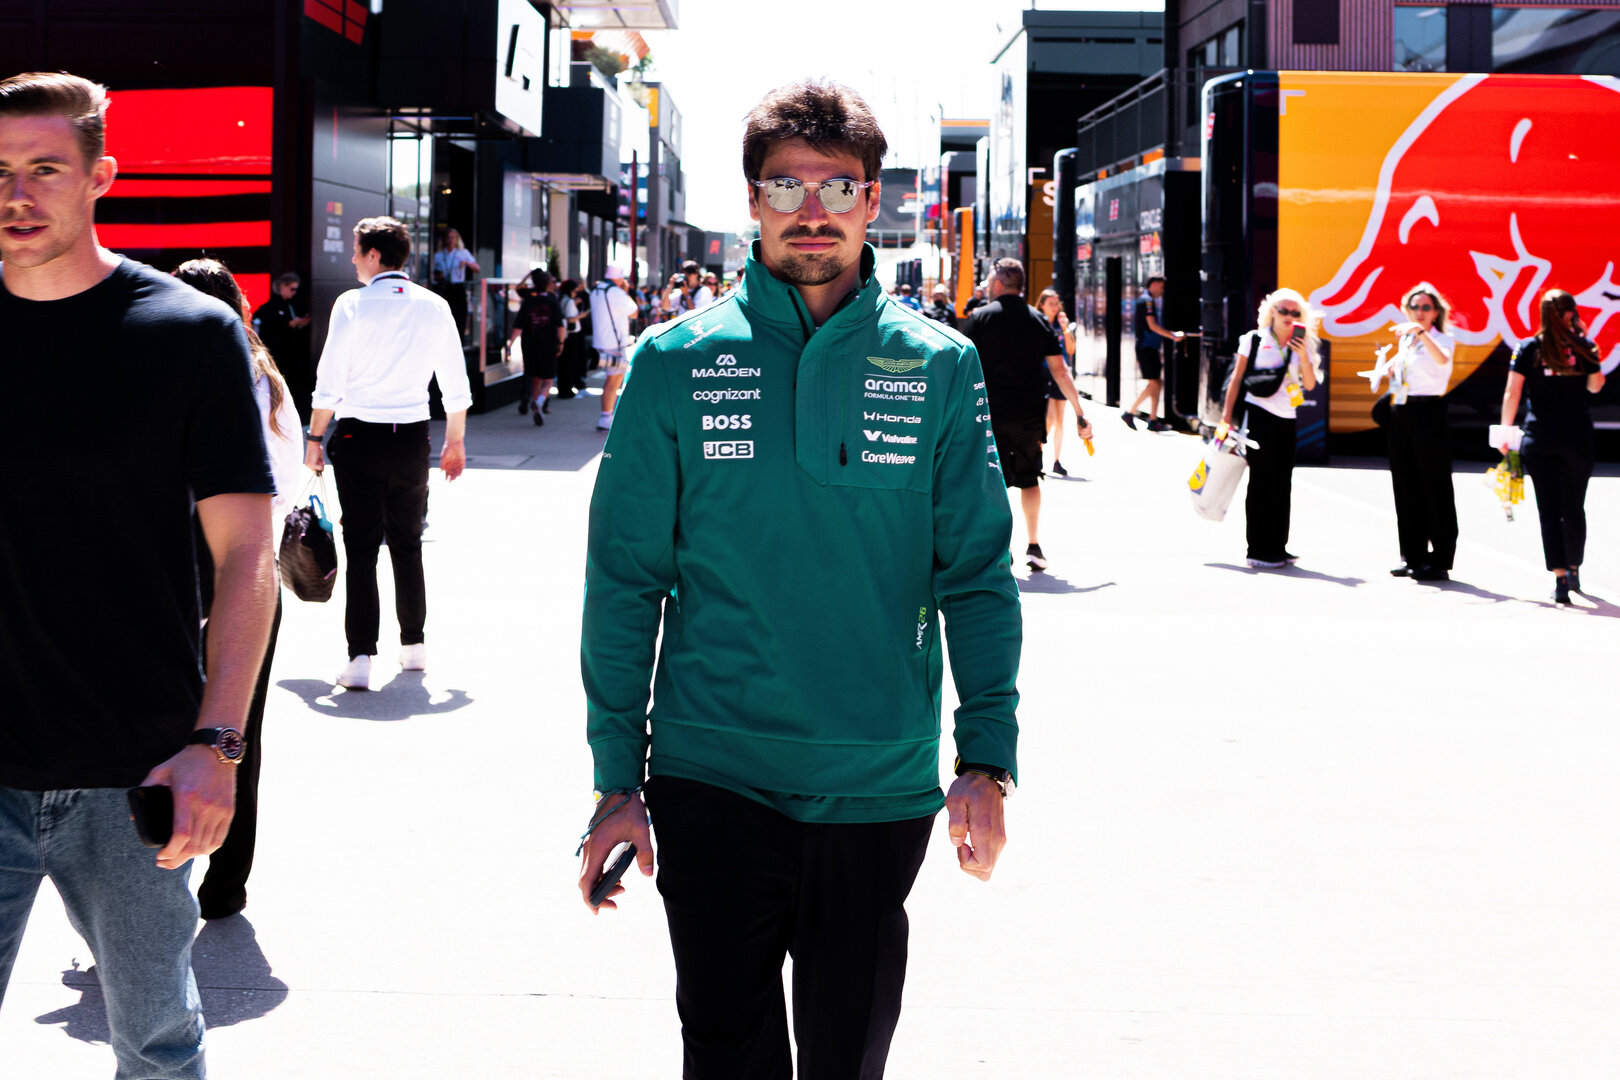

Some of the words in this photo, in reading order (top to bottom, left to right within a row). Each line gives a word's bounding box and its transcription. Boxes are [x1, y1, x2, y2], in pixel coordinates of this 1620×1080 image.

[691, 368, 761, 378] MAADEN
[864, 379, 927, 393] aramco
[692, 388, 761, 404] cognizant
[864, 392, 894, 400] FORMULA
[702, 414, 752, 430] BOSS
[876, 413, 922, 424] Honda
[881, 433, 918, 444] Valvoline
[705, 442, 752, 458] JCB
[862, 450, 916, 464] CoreWeave
